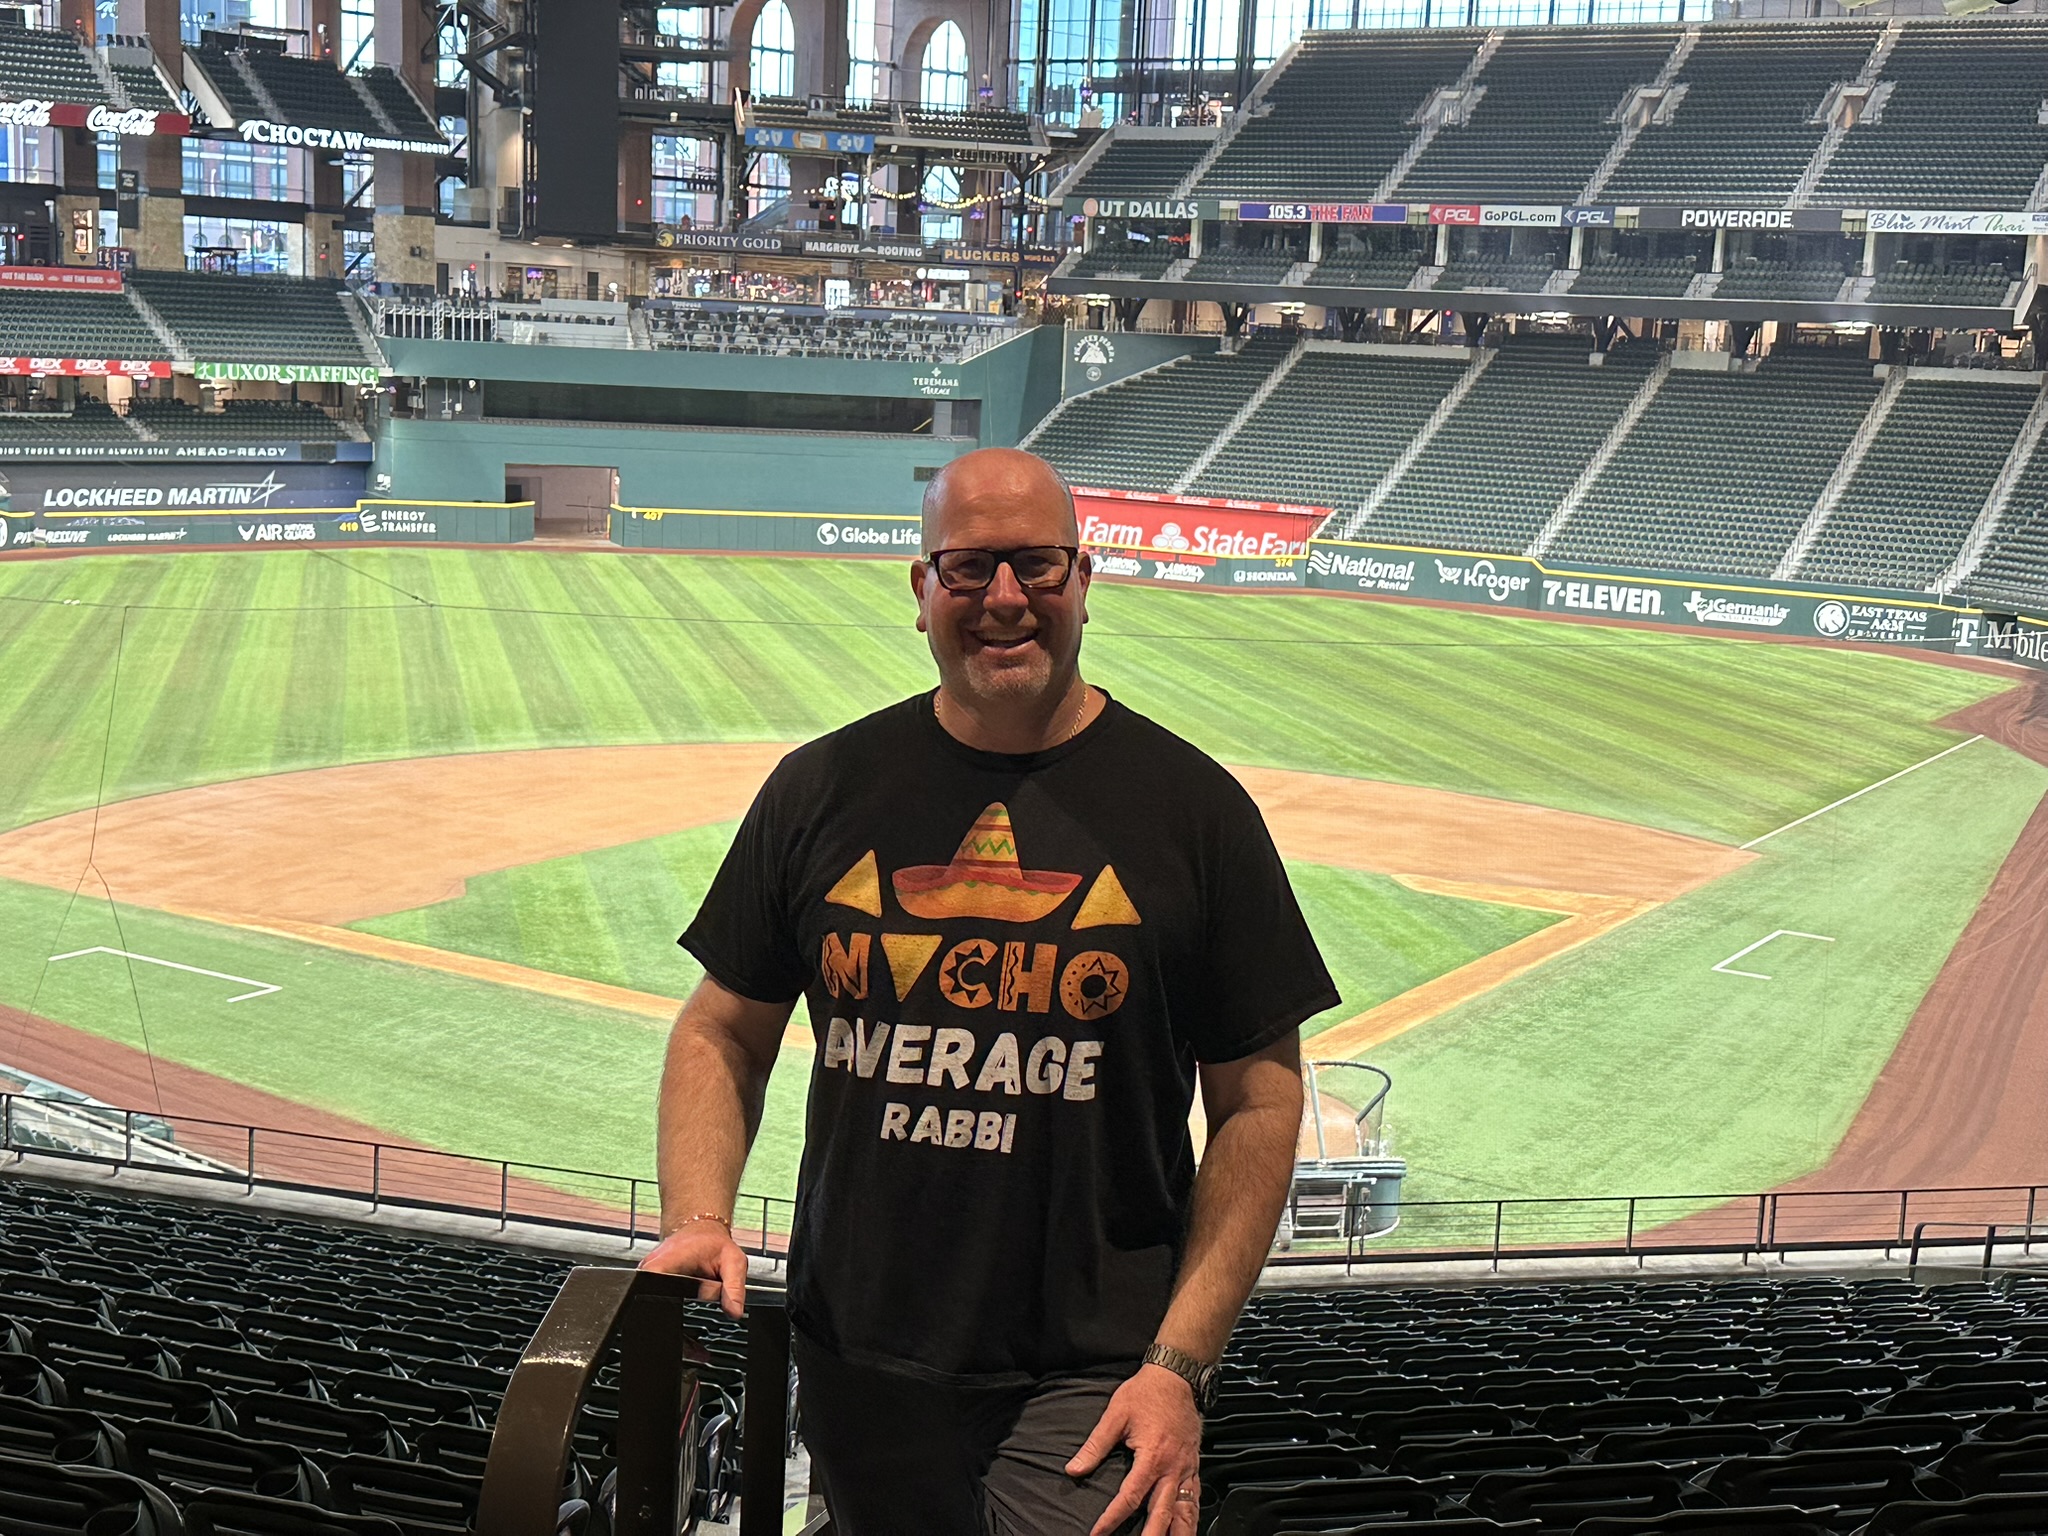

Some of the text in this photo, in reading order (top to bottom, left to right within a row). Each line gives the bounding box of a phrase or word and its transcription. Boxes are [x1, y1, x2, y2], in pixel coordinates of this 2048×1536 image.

[86, 104, 159, 136] Coca-Cola
[253, 120, 364, 150] CHOCTAW
[1099, 200, 1199, 219] UT DALLAS
[1268, 204, 1374, 221] 105.3 THE FAN
[1444, 209, 1476, 222] PGL
[1484, 210, 1556, 224] GoPGL.com
[1576, 211, 1611, 224] PGL
[1681, 210, 1794, 229] POWERADE
[1870, 212, 1916, 230] Blue
[1920, 215, 1980, 231] Mint
[1984, 214, 2025, 232] Thai
[676, 234, 781, 250] PRIORITY GOLD
[877, 245, 922, 257] ROOFING
[944, 249, 1020, 263] PLUCKERS
[215, 363, 376, 383] LUXOR STAFFING
[108, 447, 144, 456] ALWAYS
[147, 447, 170, 456] STAY
[175, 446, 287, 457] AHEAD-READY
[44, 487, 251, 507] LOCKHEED MARTIN
[381, 511, 426, 521] ENERGY
[255, 523, 283, 541] AIR
[339, 522, 359, 532] 410
[381, 522, 437, 533] TRANSFER
[841, 526, 921, 545] Globe Life
[1083, 515, 1143, 547] Farm
[1191, 526, 1258, 557] State
[1275, 558, 1293, 568] 374
[1331, 554, 1415, 582] National
[1246, 570, 1297, 583] HONDA
[1358, 577, 1410, 592] Car Rental
[1464, 560, 1530, 601] Kroger
[1713, 598, 1790, 619] Germania
[1851, 605, 1928, 622] EAST TEXAS
[1870, 618, 1906, 632] A&M
[1983, 621, 2048, 662] Mbile
[824, 1017, 1105, 1101] AVERAGE
[880, 1102, 1017, 1154] RABBI
